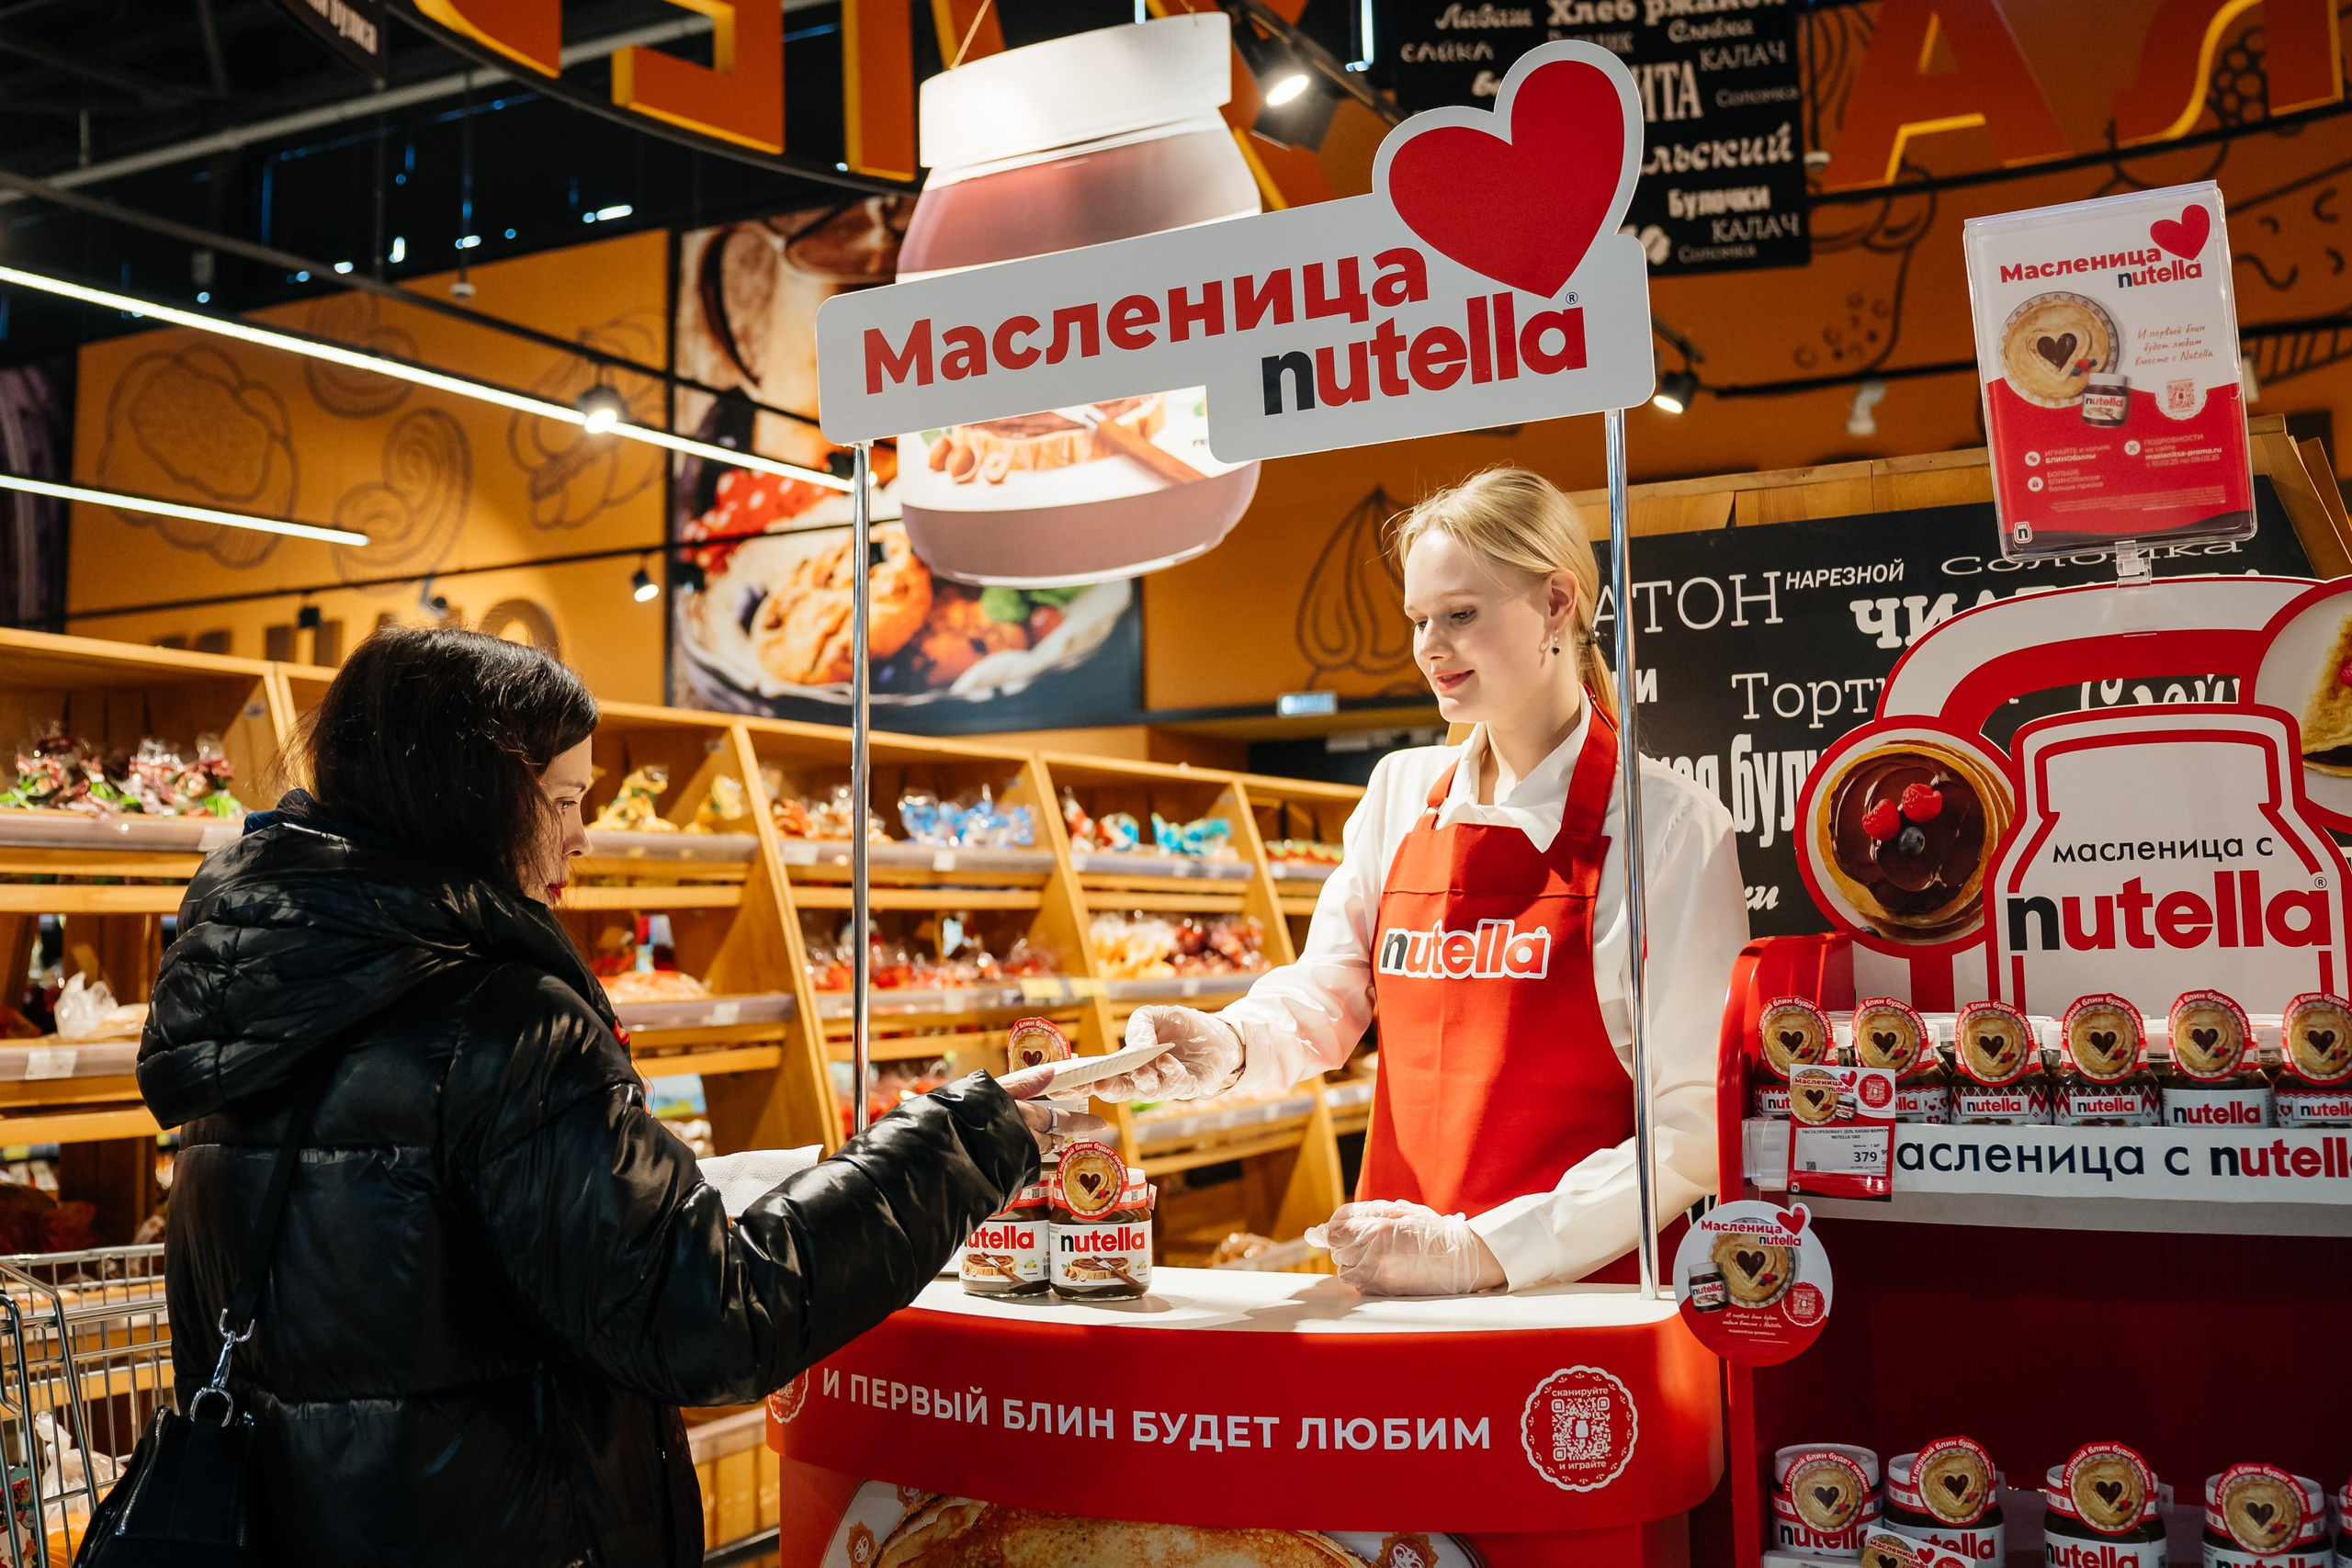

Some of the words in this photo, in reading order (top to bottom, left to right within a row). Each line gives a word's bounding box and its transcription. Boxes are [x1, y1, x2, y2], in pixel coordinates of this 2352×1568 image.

[1700, 39, 1788, 72] КАЛАЧ
[1711, 211, 1801, 243] КАЛАЧ
[1999, 247, 2163, 284] Масленица
[2117, 259, 2203, 289] nutella
[863, 246, 1430, 397] Масленица
[2137, 329, 2147, 340] И
[2150, 326, 2183, 339] первый
[2185, 323, 2206, 333] блин
[1261, 290, 1589, 417] nutella
[2143, 341, 2169, 354] будет
[2172, 337, 2202, 349] любим
[2179, 348, 2214, 362] Nutella
[2085, 395, 2124, 407] nutella
[1785, 557, 1905, 591] НАРЕЗНОЙ
[1731, 671, 1886, 729] Торт
[2052, 836, 2244, 864] масленица
[2256, 836, 2274, 857] с
[2007, 869, 2333, 952] nutella
[1381, 921, 1547, 976] nutella
[1970, 1000, 1992, 1010] блин
[1992, 1000, 2017, 1016] будет
[2081, 996, 2104, 1006] блин
[2105, 996, 2130, 1011] будет
[2184, 993, 2206, 1002] блин
[2207, 991, 2233, 1008] будет
[2299, 994, 2323, 1003] блин
[2324, 993, 2350, 1009] будет
[1794, 1077, 1843, 1087] Масленица
[1966, 1097, 2021, 1113] nutella
[2077, 1097, 2135, 1113] nutella
[2173, 1100, 2261, 1124] nutella
[1075, 1142, 1092, 1151] блин
[1093, 1142, 1114, 1156] будет
[1853, 1151, 1878, 1163] 379
[2210, 1135, 2352, 1179] nutell
[1895, 1141, 2145, 1182] асленица
[2164, 1145, 2190, 1177] с
[1701, 1220, 1783, 1235] Масленица
[965, 1224, 1035, 1250] utella
[1060, 1226, 1145, 1253] nutella
[1758, 1234, 1802, 1247] nutella
[1691, 1283, 1724, 1296] nutella
[1551, 1386, 1609, 1398] сканируйте
[822, 1367, 840, 1398] И
[850, 1372, 988, 1426] ПЕРВЫЙ
[1002, 1397, 1114, 1440] БЛИН
[1132, 1410, 1280, 1452] БУДЕТ
[1295, 1416, 1490, 1450] ЛЮБИМ
[1935, 1440, 1957, 1450] блин
[1958, 1438, 1980, 1453] будет
[2087, 1445, 2111, 1454] блин
[2111, 1444, 2137, 1461] будет
[1558, 1462, 1566, 1471] и
[1567, 1460, 1607, 1471] играйте
[1805, 1452, 1827, 1461] блин
[1828, 1452, 1852, 1467] будет
[1869, 1539, 1919, 1562] Масленица
